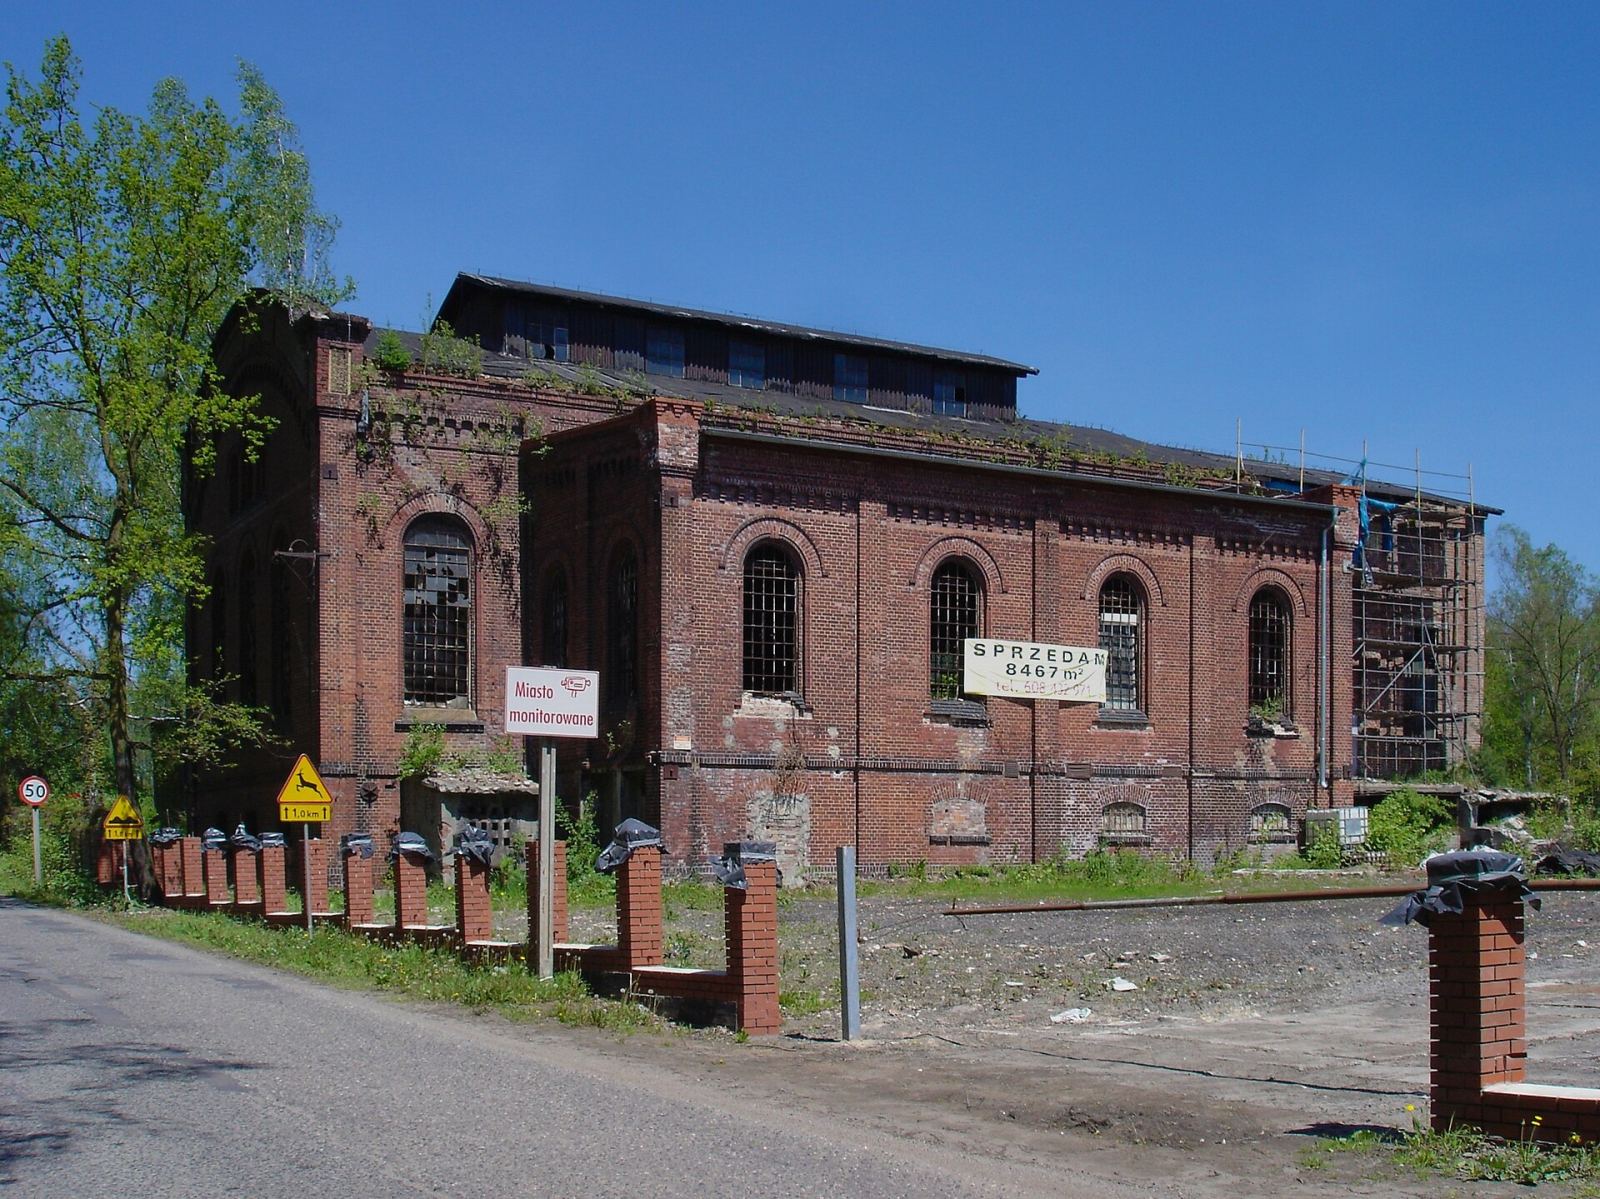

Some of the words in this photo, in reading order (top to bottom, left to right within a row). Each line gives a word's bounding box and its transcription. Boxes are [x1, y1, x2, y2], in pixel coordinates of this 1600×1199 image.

[973, 643, 1105, 666] SPRZEDAM
[1006, 663, 1058, 678] 8467
[515, 681, 554, 699] Miasto
[996, 679, 1018, 692] tel.
[509, 708, 594, 726] monitorowane
[25, 784, 46, 798] 50
